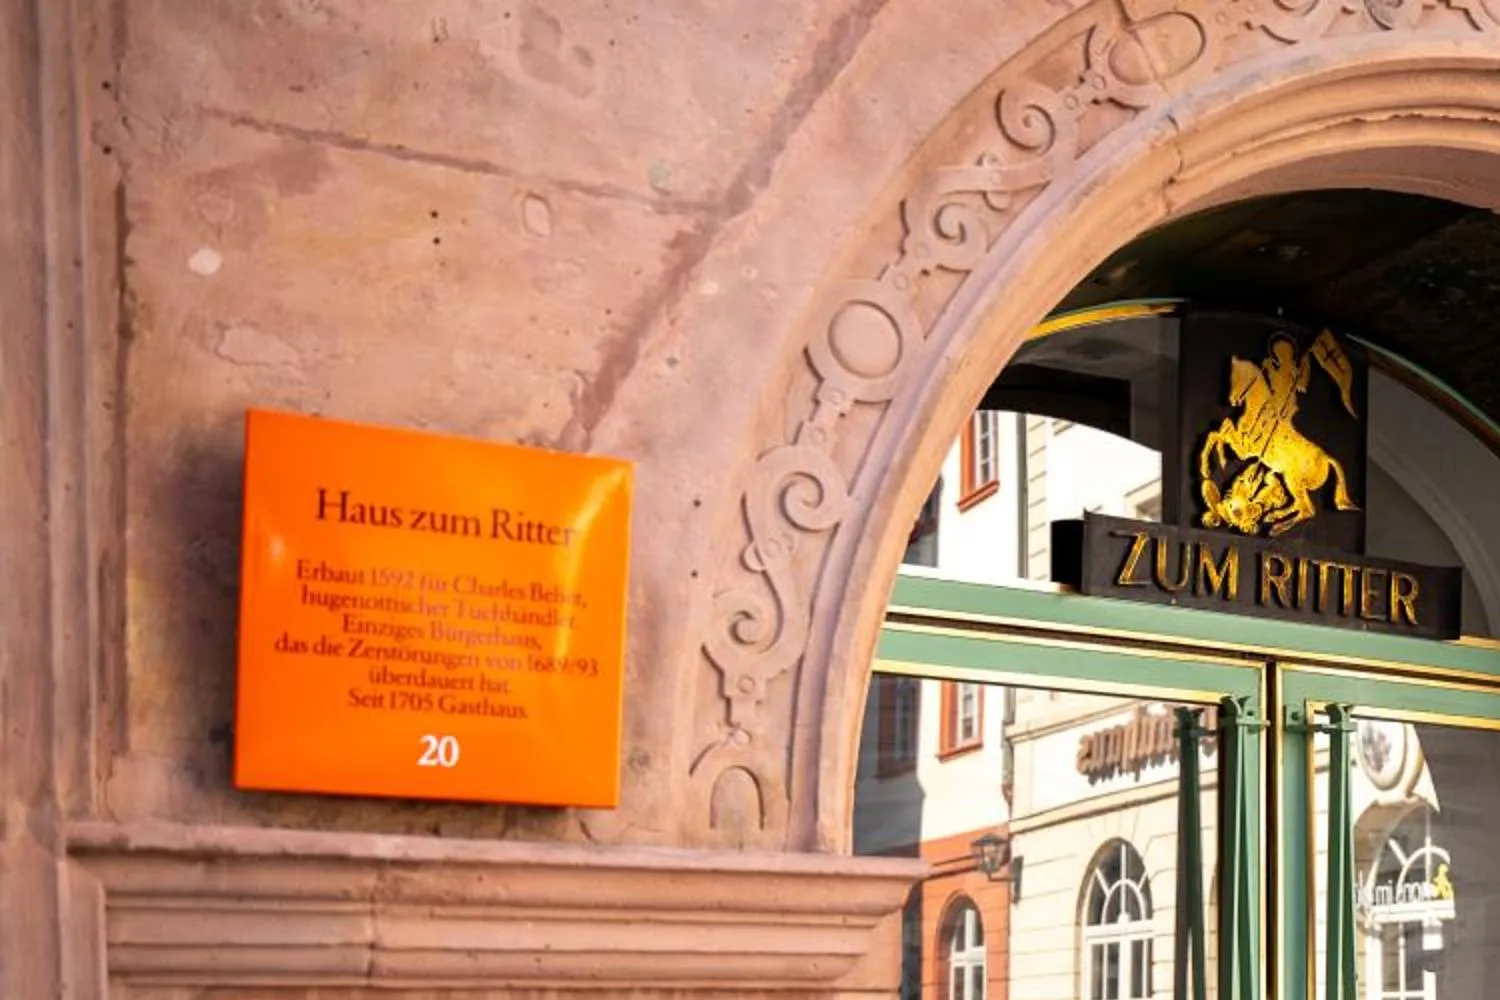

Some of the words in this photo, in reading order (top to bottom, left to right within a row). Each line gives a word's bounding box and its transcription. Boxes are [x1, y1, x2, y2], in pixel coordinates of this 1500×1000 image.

[316, 487, 403, 528] Haus
[409, 509, 481, 538] zum
[491, 508, 575, 547] Ritter
[297, 559, 364, 586] Erbaut
[370, 567, 414, 591] 1592
[452, 575, 526, 601] Charles
[1111, 529, 1240, 601] ZUM
[1261, 550, 1420, 626] RITTER
[302, 584, 449, 617] hugenottischer
[274, 630, 308, 655] das
[312, 633, 344, 657] die
[347, 637, 480, 670] Zerstörungen
[485, 655, 521, 671] von
[343, 613, 424, 642] Einziges
[430, 619, 543, 651] Bürgerhaus,
[368, 665, 475, 692] überdauert
[348, 687, 384, 709] Seit
[389, 691, 434, 713] 1705
[417, 734, 461, 768] 20
